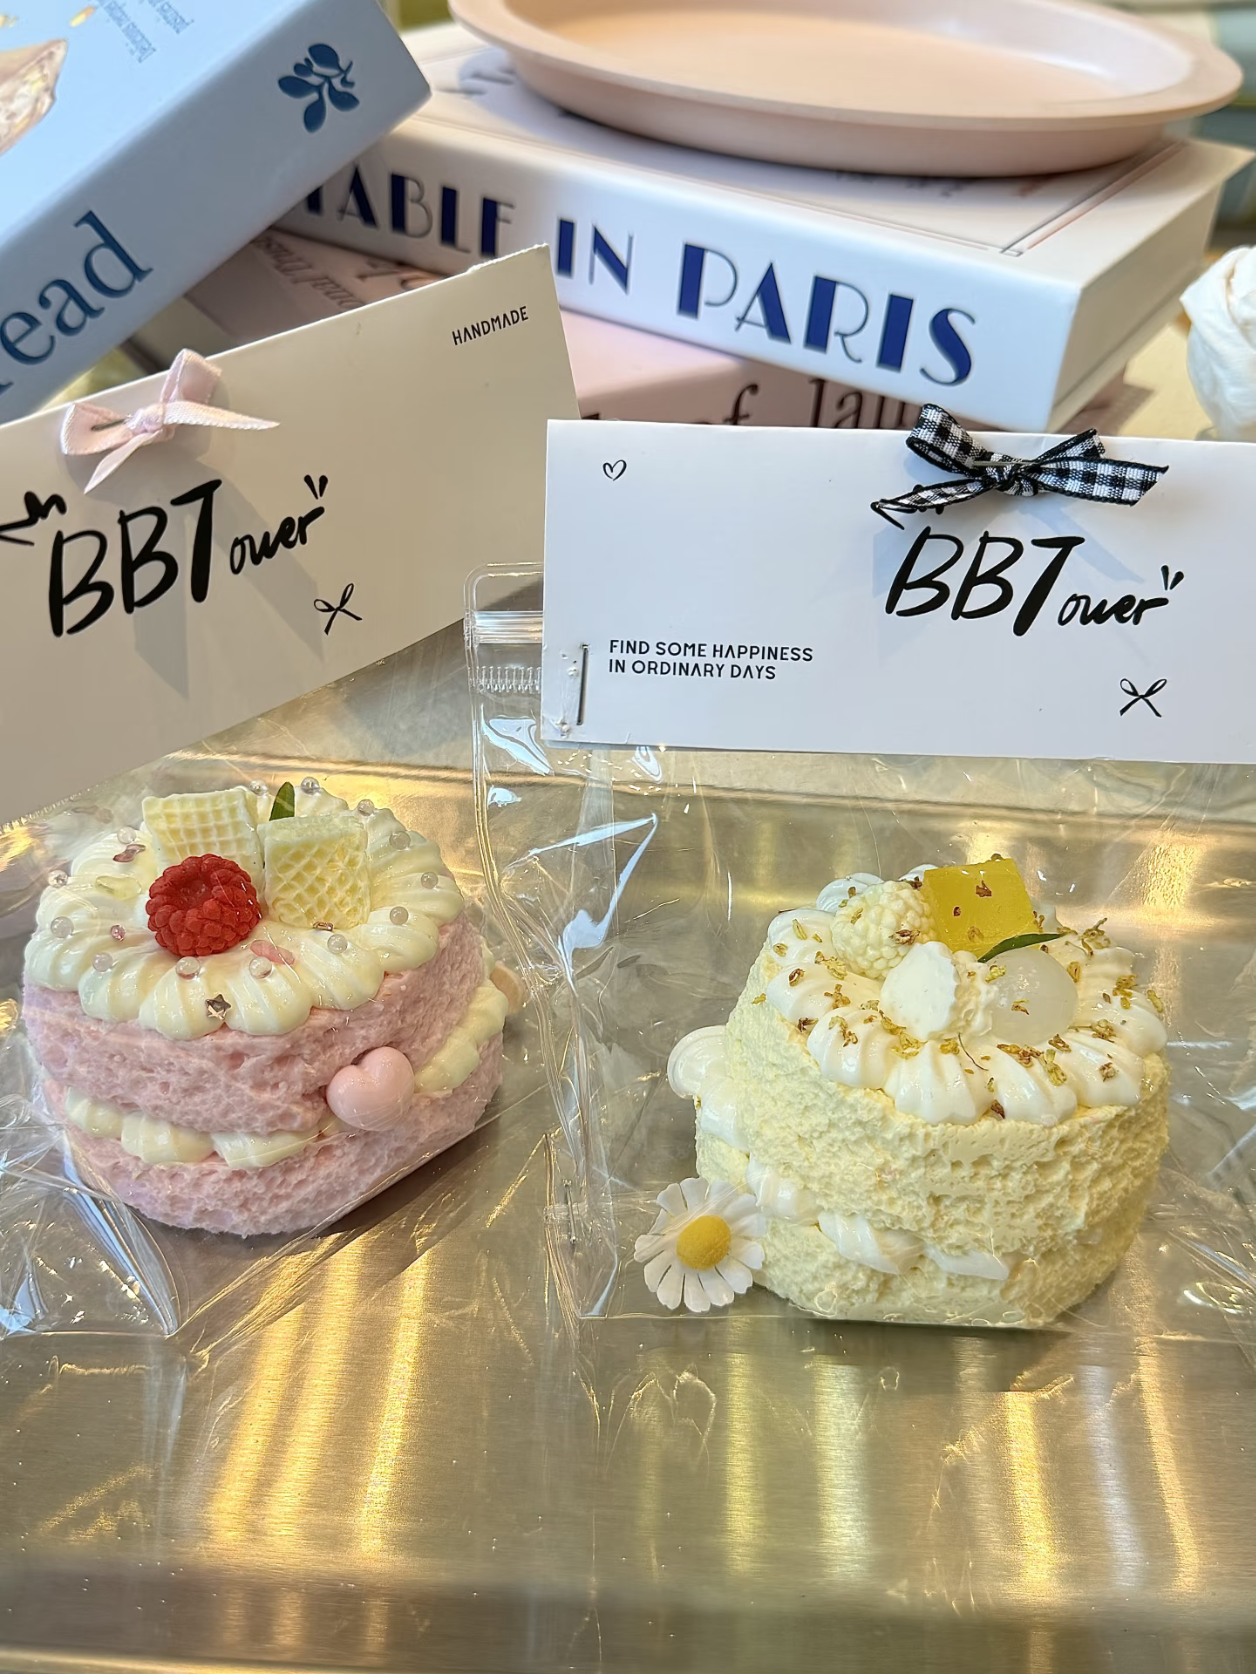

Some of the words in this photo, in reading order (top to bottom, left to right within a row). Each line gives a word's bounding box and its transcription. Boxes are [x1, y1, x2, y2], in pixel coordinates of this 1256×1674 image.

[305, 165, 515, 259] ABLE
[555, 217, 635, 296] IN
[677, 242, 976, 386] PARIS
[0, 210, 153, 396] ead
[452, 306, 529, 346] HANDMADE
[608, 658, 626, 674] IN
[631, 660, 725, 678] ORDINARY
[730, 664, 776, 680] DAYS
[609, 639, 650, 656] FIND
[655, 641, 707, 658] SOME
[712, 643, 814, 662] HAPPINESS
